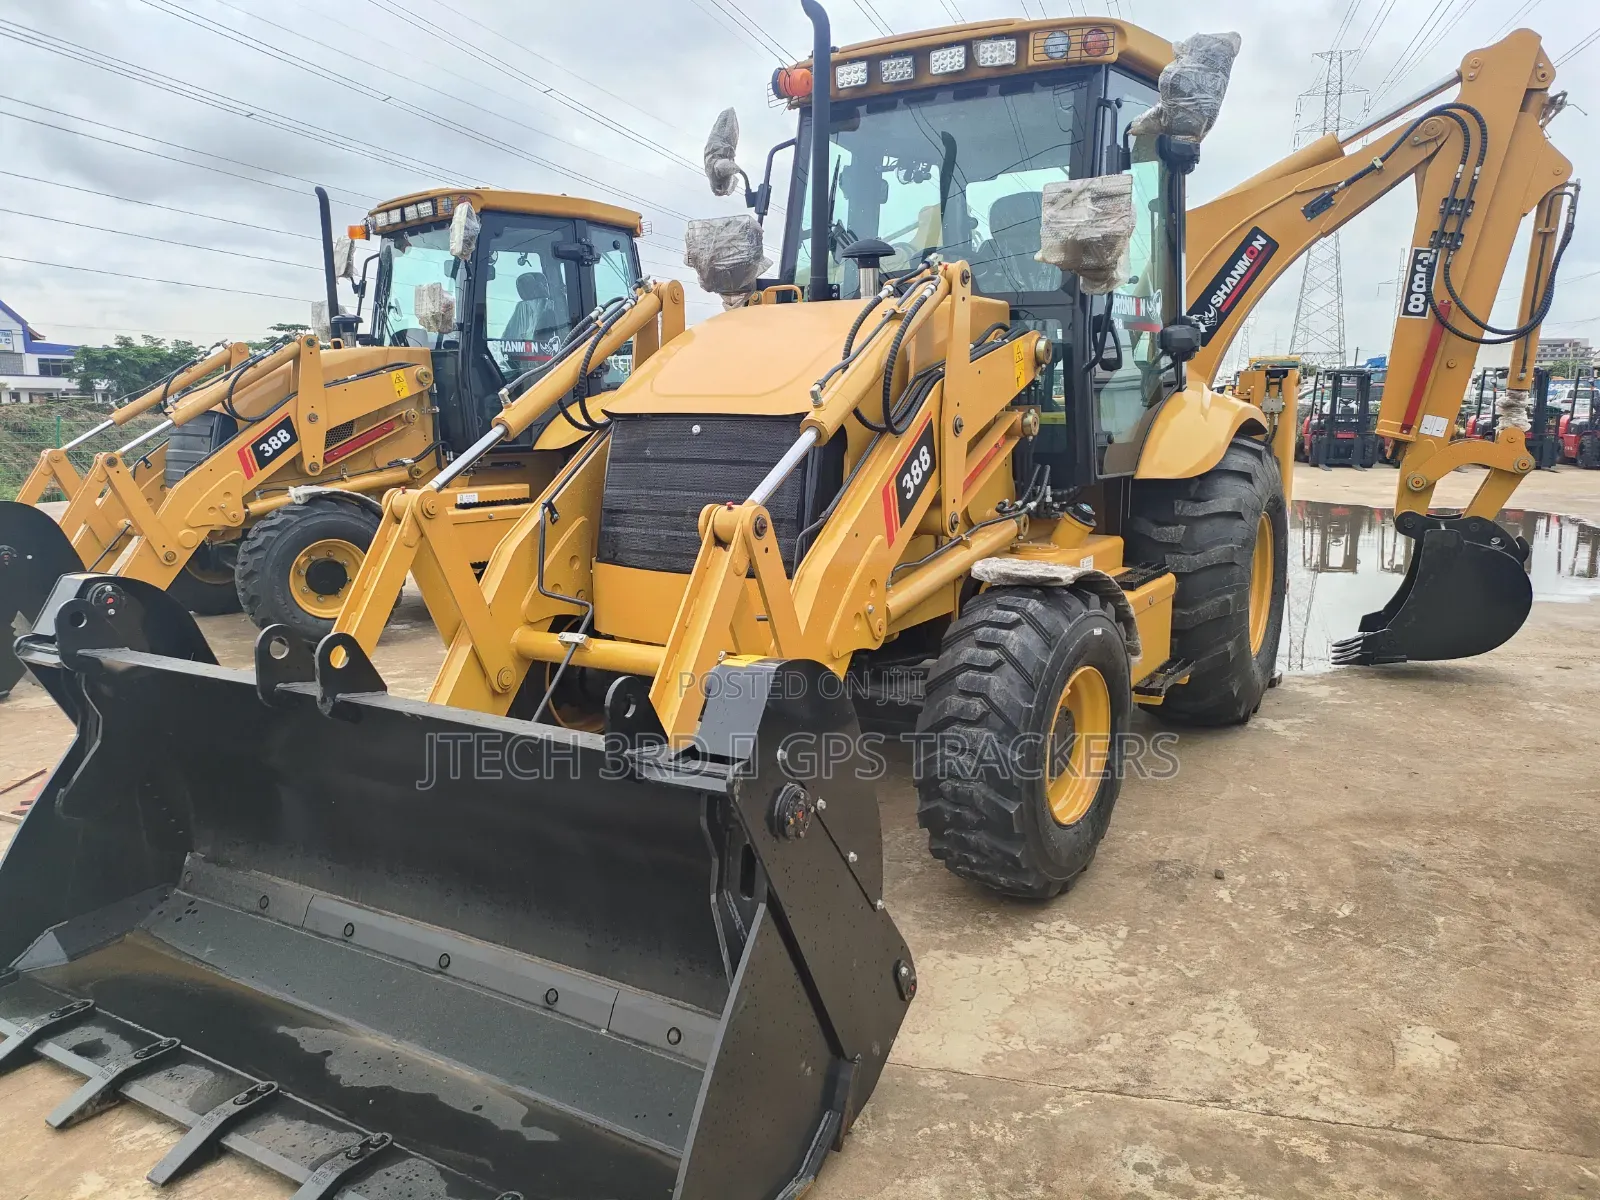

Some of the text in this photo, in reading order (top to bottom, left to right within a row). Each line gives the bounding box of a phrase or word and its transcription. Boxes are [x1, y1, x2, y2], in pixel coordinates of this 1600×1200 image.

[1210, 234, 1267, 308] SHANMON
[1407, 252, 1432, 313] 388
[1111, 294, 1146, 316] HANMON
[492, 340, 539, 353] SHANMON
[259, 429, 291, 457] 388
[902, 445, 931, 500] 388
